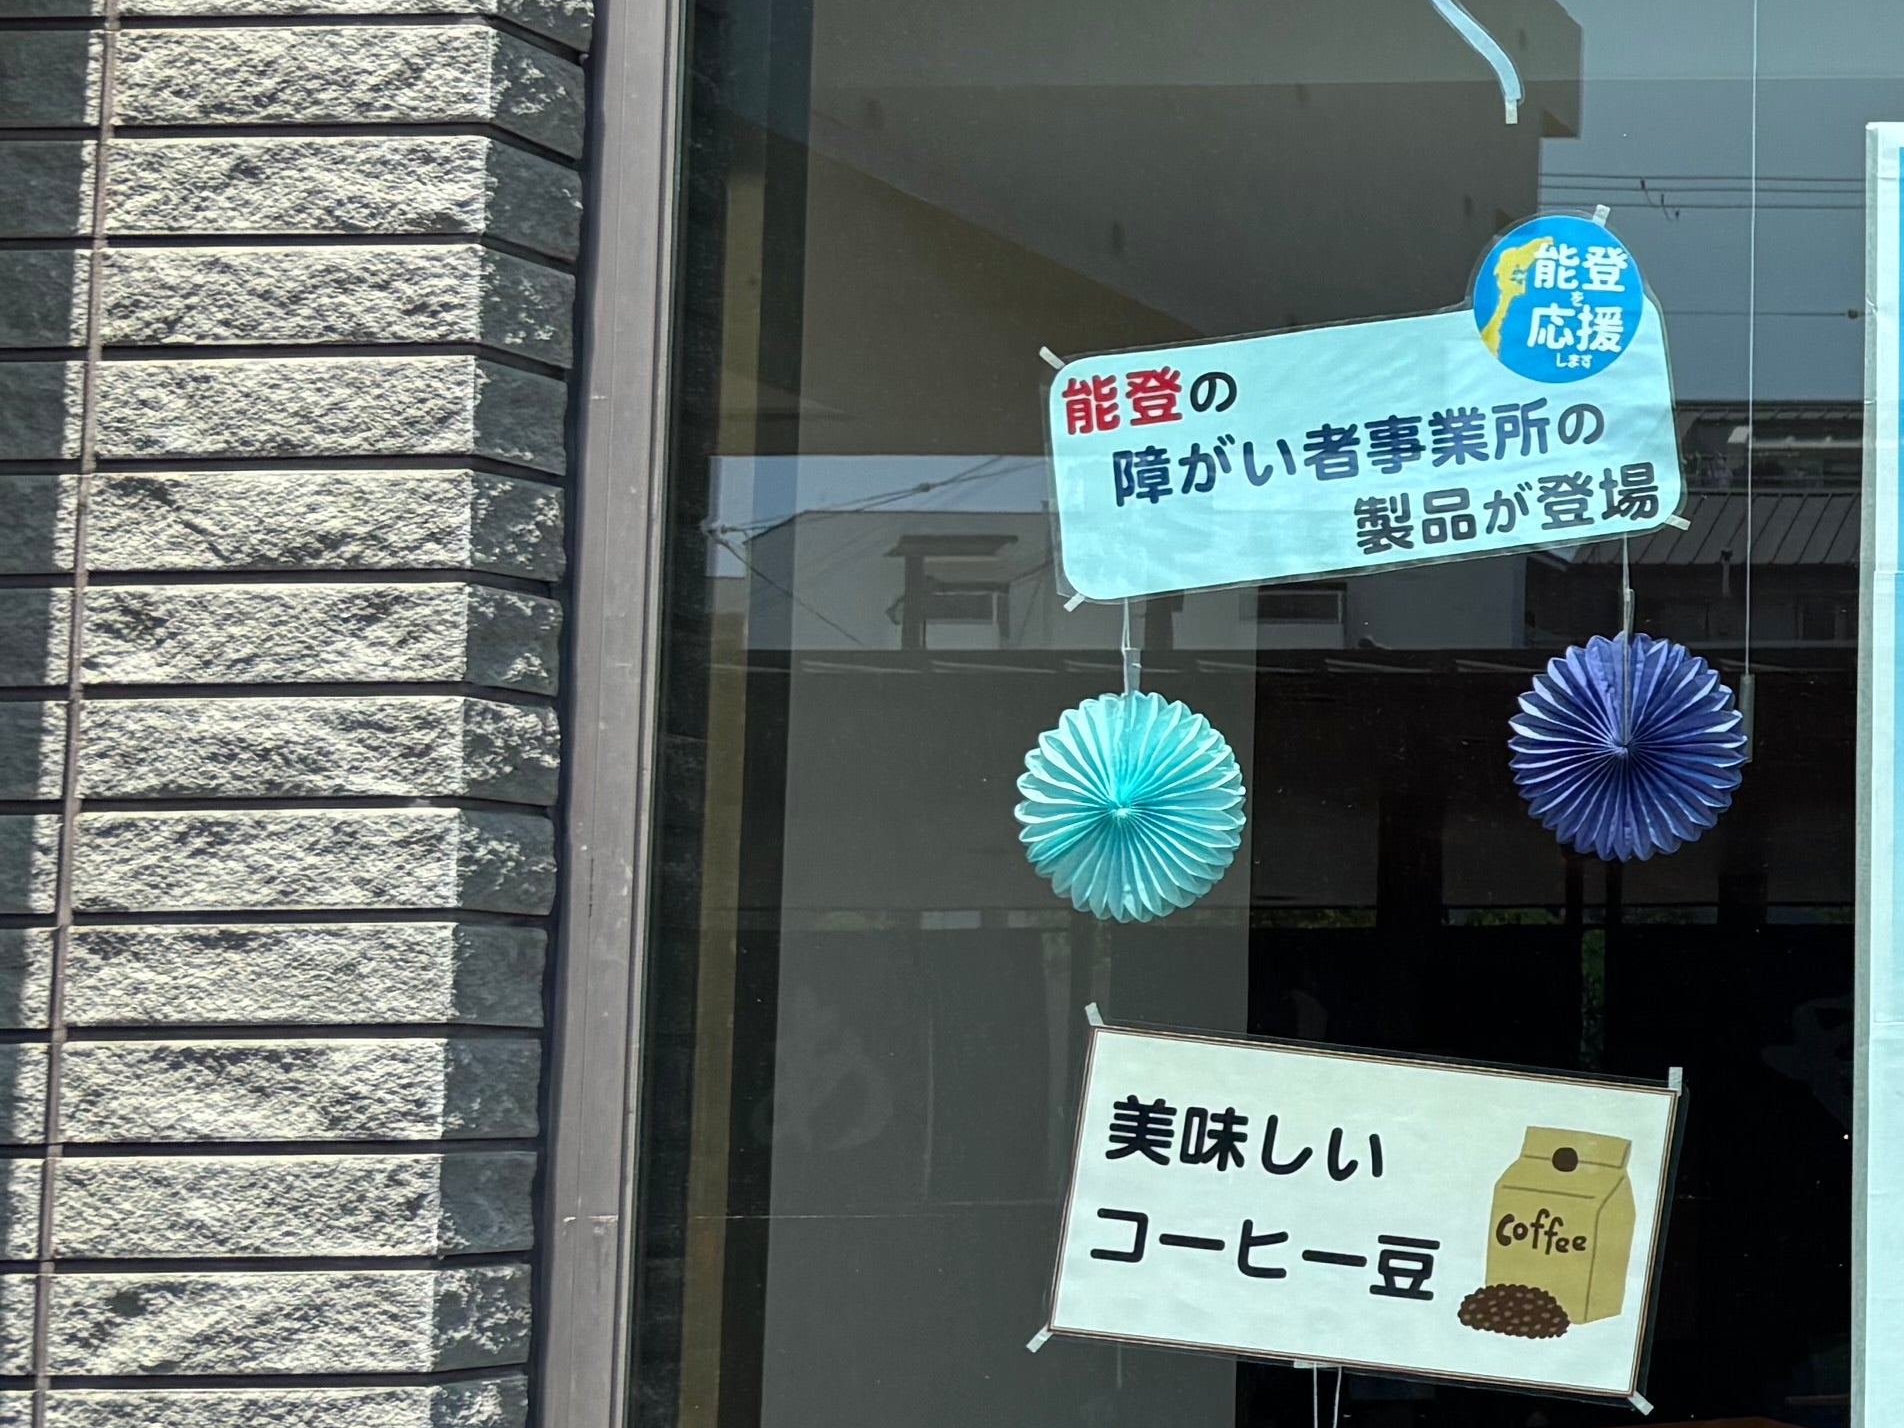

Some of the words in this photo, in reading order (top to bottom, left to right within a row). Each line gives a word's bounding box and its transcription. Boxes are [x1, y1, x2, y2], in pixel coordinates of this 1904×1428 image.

[1534, 243, 1628, 292] 能登
[1570, 291, 1584, 307] を
[1527, 303, 1624, 353] 応援
[1556, 353, 1593, 369] します
[1062, 370, 1238, 435] 能登の
[1112, 397, 1605, 507] 障がい者事業所の
[1355, 462, 1660, 555] 製品が登場
[1105, 1095, 1383, 1183] 美味しい
[1089, 1207, 1441, 1303] コーヒー豆
